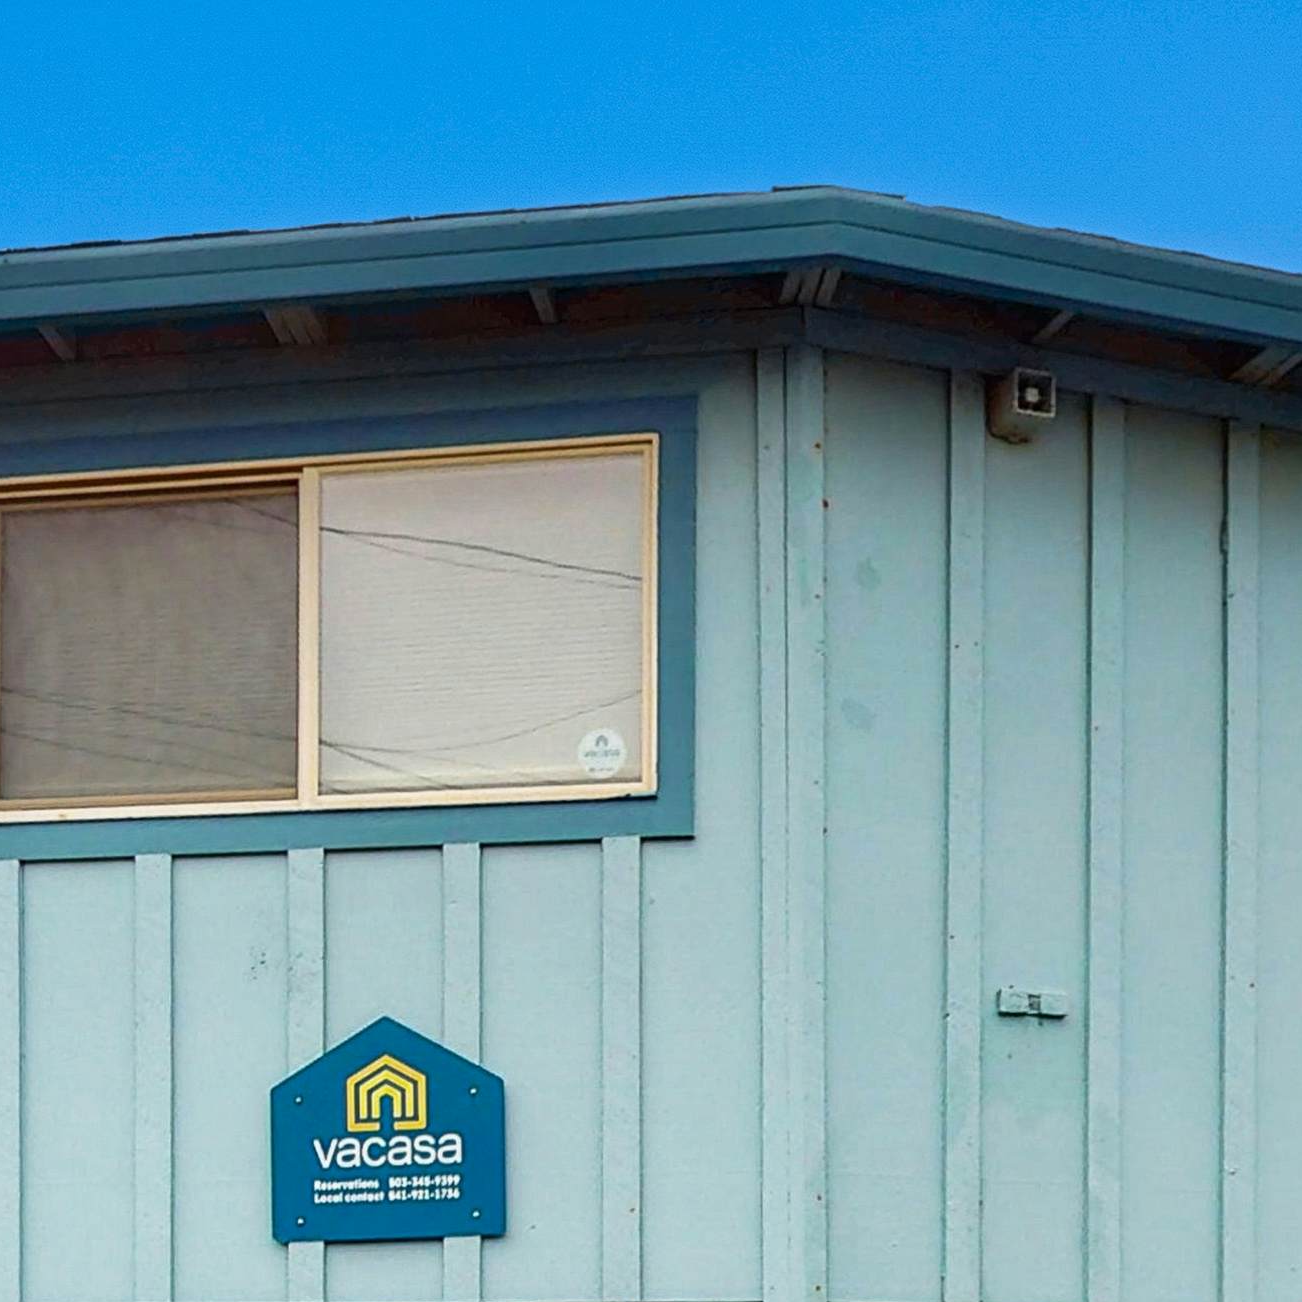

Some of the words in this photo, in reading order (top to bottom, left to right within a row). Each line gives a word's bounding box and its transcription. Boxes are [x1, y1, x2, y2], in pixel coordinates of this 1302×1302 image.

[312, 1132, 463, 1169] vacasa
[313, 1178, 380, 1191] Reservations
[313, 1193, 344, 1205] Local
[344, 1191, 385, 1203] contact
